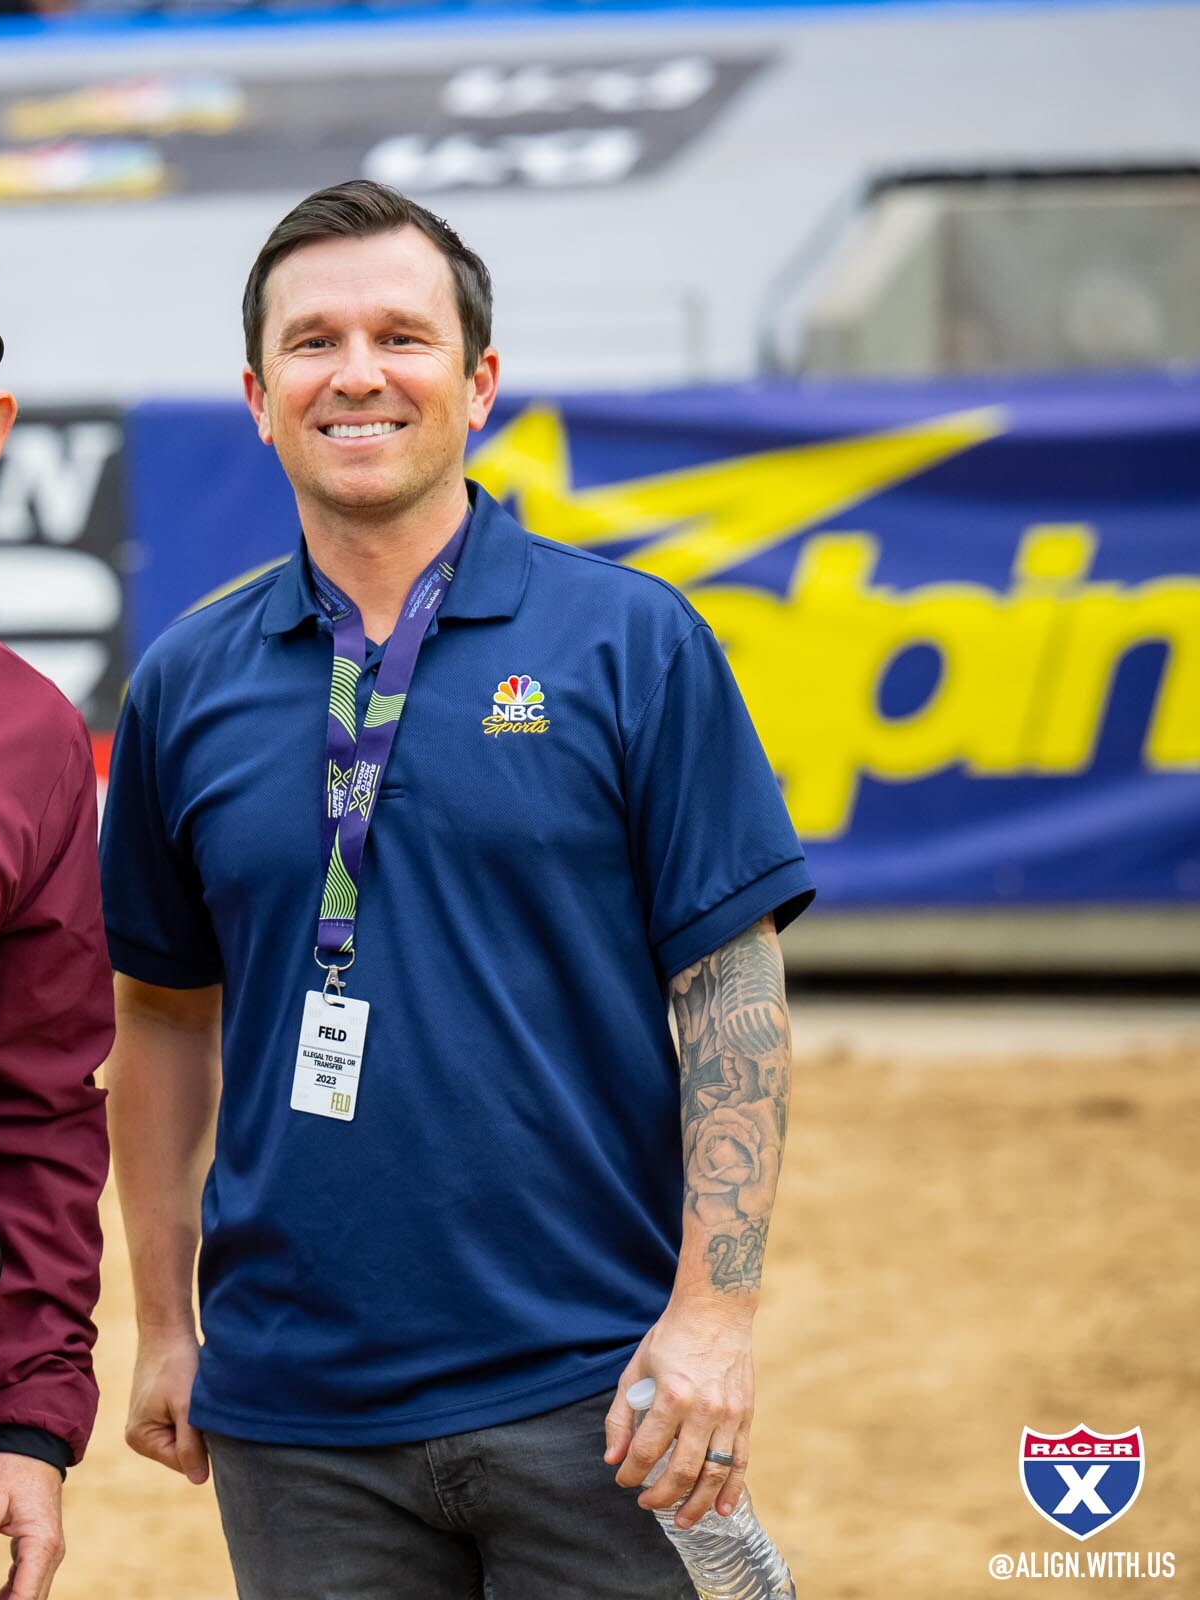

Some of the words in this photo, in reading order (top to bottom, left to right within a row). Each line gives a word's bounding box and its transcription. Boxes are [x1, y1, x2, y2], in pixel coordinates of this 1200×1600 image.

[492, 704, 545, 721] NBC
[481, 715, 551, 738] Sports
[318, 1025, 347, 1042] FELD
[302, 1050, 325, 1061] ILLEGAL
[325, 1054, 334, 1062] TO
[333, 1056, 347, 1065] SELL
[346, 1058, 356, 1067] OR
[313, 1059, 343, 1071] TRANSFER
[315, 1073, 337, 1085] 2023
[330, 1092, 351, 1113] FELD
